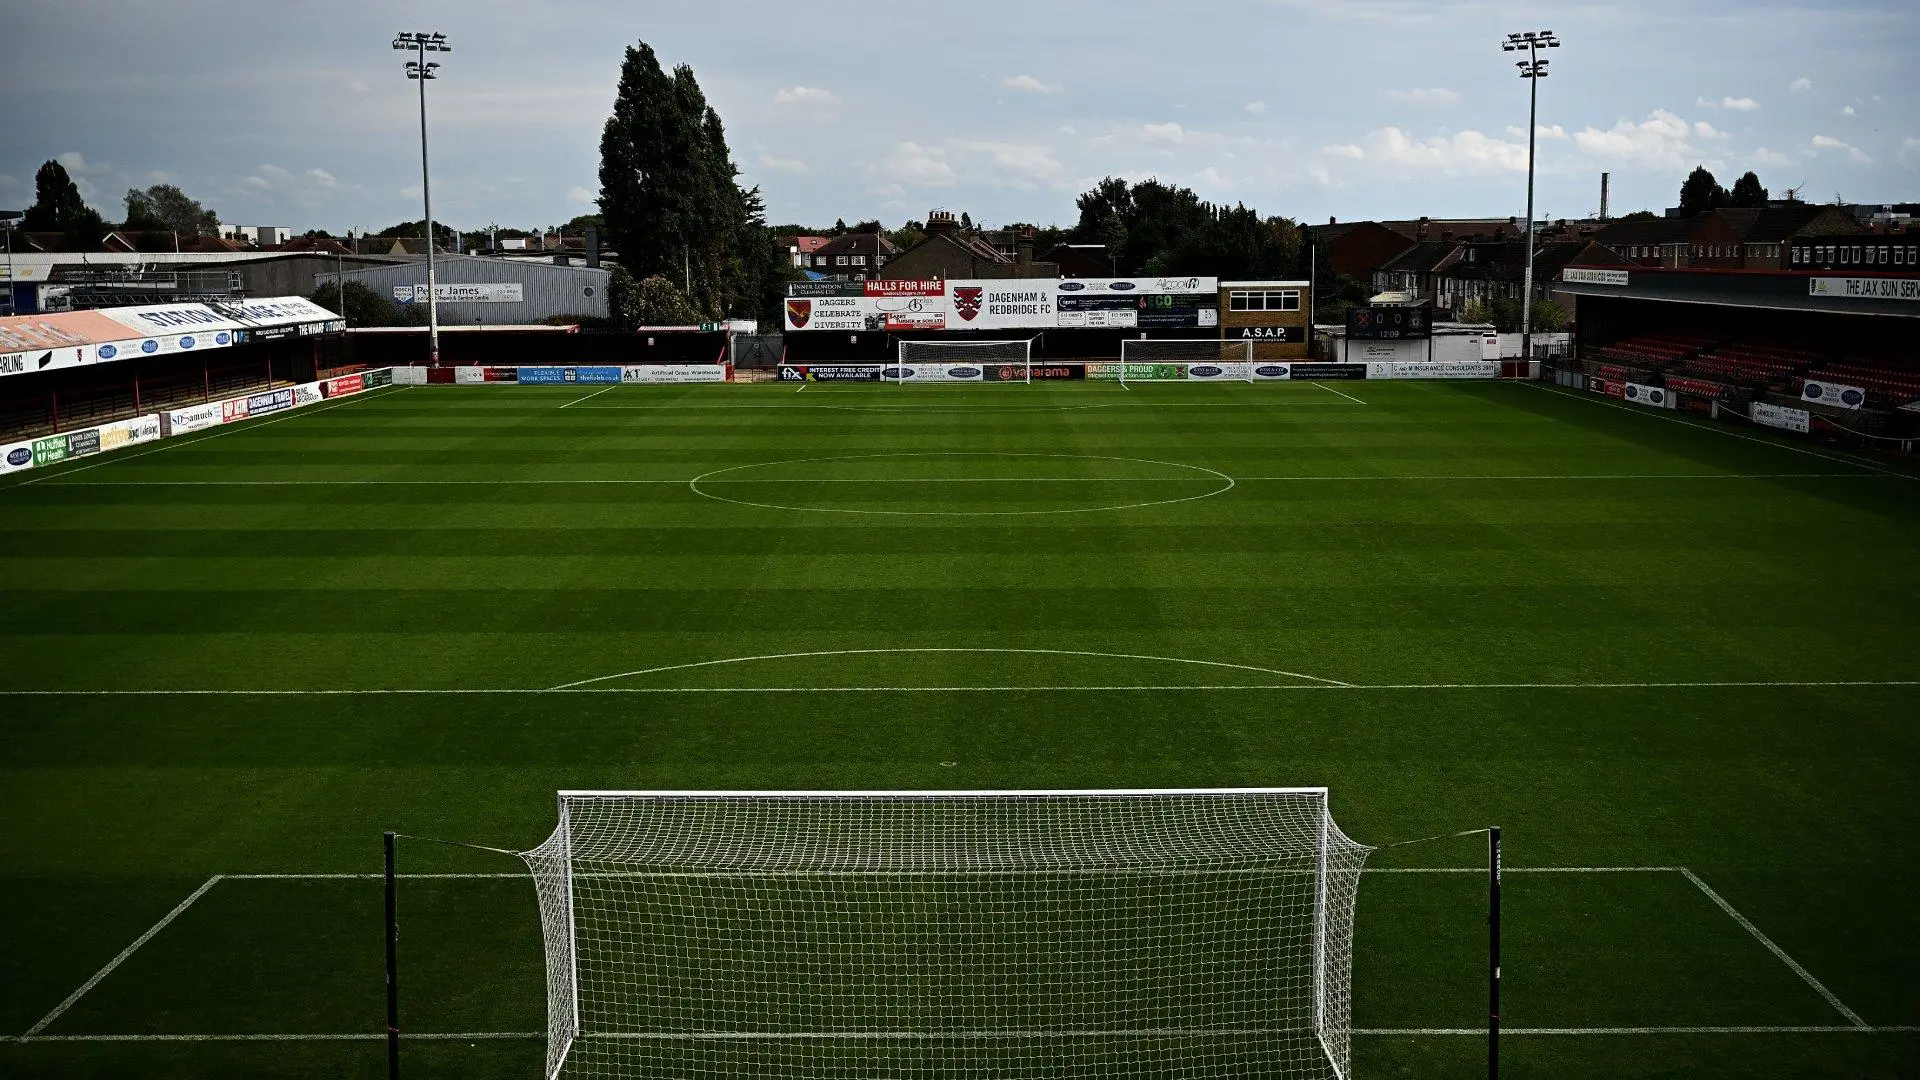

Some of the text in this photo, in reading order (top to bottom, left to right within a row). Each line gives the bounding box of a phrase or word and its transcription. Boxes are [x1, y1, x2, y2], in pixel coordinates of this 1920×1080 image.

[417, 287, 479, 295] Peer James
[868, 281, 941, 291] HALLS FOR HIRE
[1846, 280, 1860, 295] THE
[1862, 280, 1877, 295] JAX
[1881, 281, 1898, 296] SUN
[989, 293, 1047, 302] DAGENHAM &
[989, 305, 1051, 314] REDBRIDGE FC
[1394, 314, 1401, 324] 0
[1243, 328, 1286, 337] A.S.A.P.
[1013, 368, 1069, 376] vanarama
[274, 390, 290, 403] TRAVEL
[46, 438, 66, 450] Nuffield
[48, 448, 64, 460] Health
